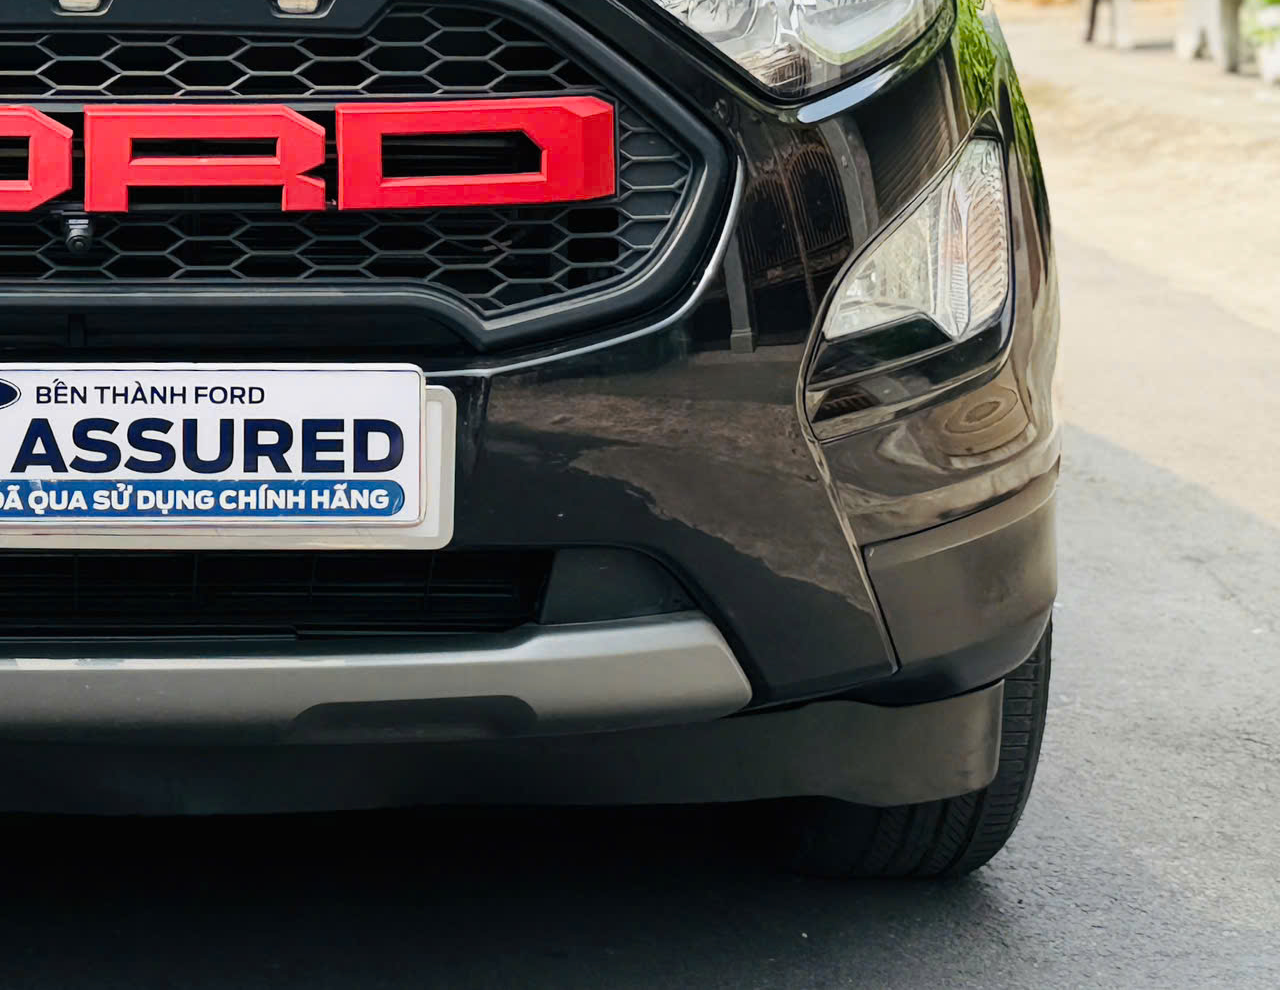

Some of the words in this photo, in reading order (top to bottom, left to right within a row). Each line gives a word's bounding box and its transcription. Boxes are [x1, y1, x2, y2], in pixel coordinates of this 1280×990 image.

[35, 378, 88, 405] BẾN
[94, 380, 187, 405] THÀNH
[194, 386, 265, 405] FORD
[10, 417, 405, 474] ASSURED
[27, 489, 89, 515] QUA
[92, 482, 135, 511] SỬ
[136, 488, 214, 515] DỤNG
[219, 483, 306, 510] CHÍNH
[311, 482, 389, 510] HÃNG
